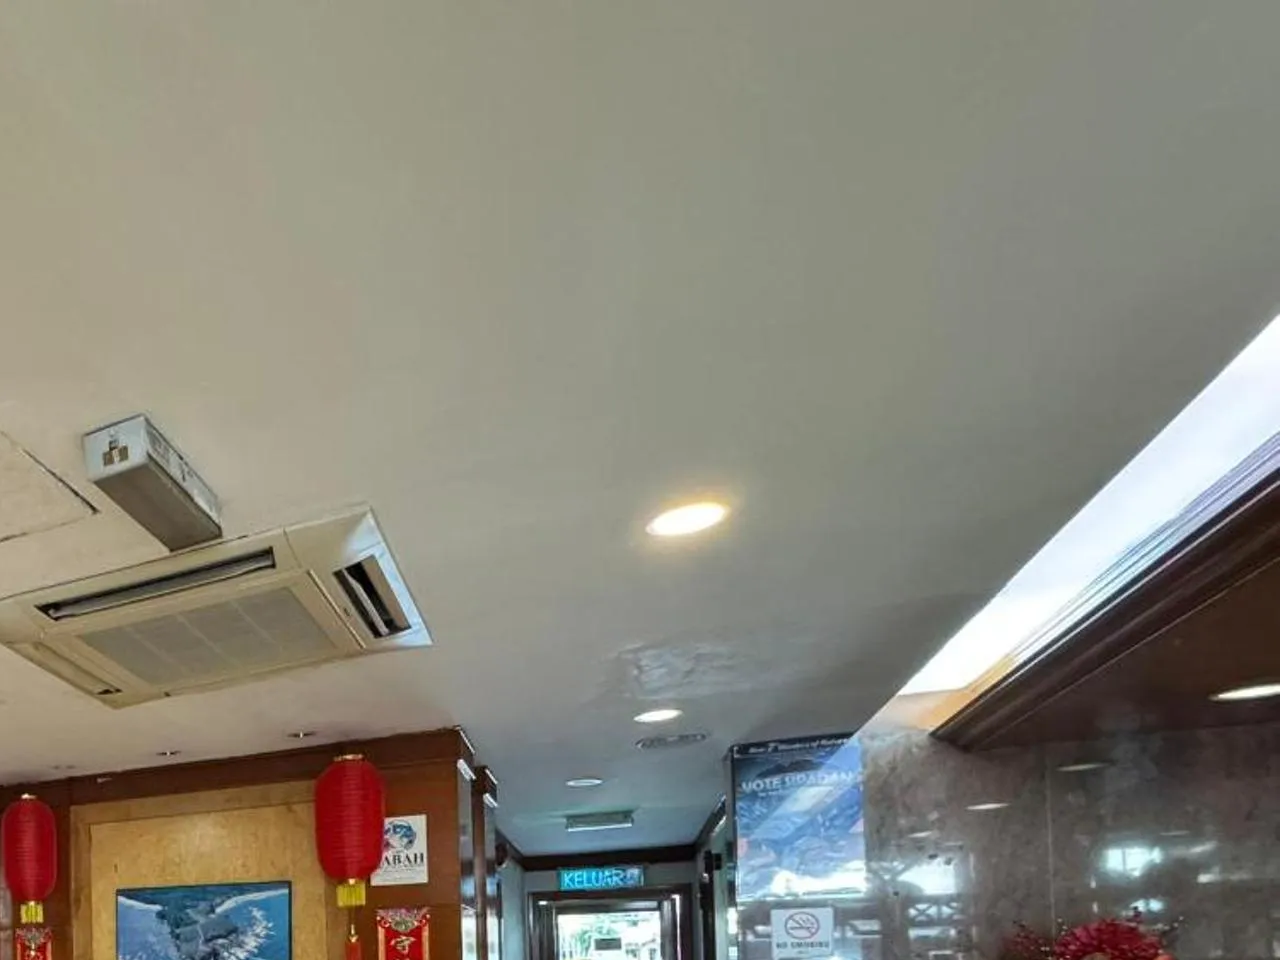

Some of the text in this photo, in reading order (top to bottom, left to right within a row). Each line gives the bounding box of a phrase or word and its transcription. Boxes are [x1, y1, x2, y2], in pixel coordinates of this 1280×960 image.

[741, 777, 781, 793] VOTE
[382, 851, 425, 868] ABAH
[563, 867, 626, 889] KELUAR
